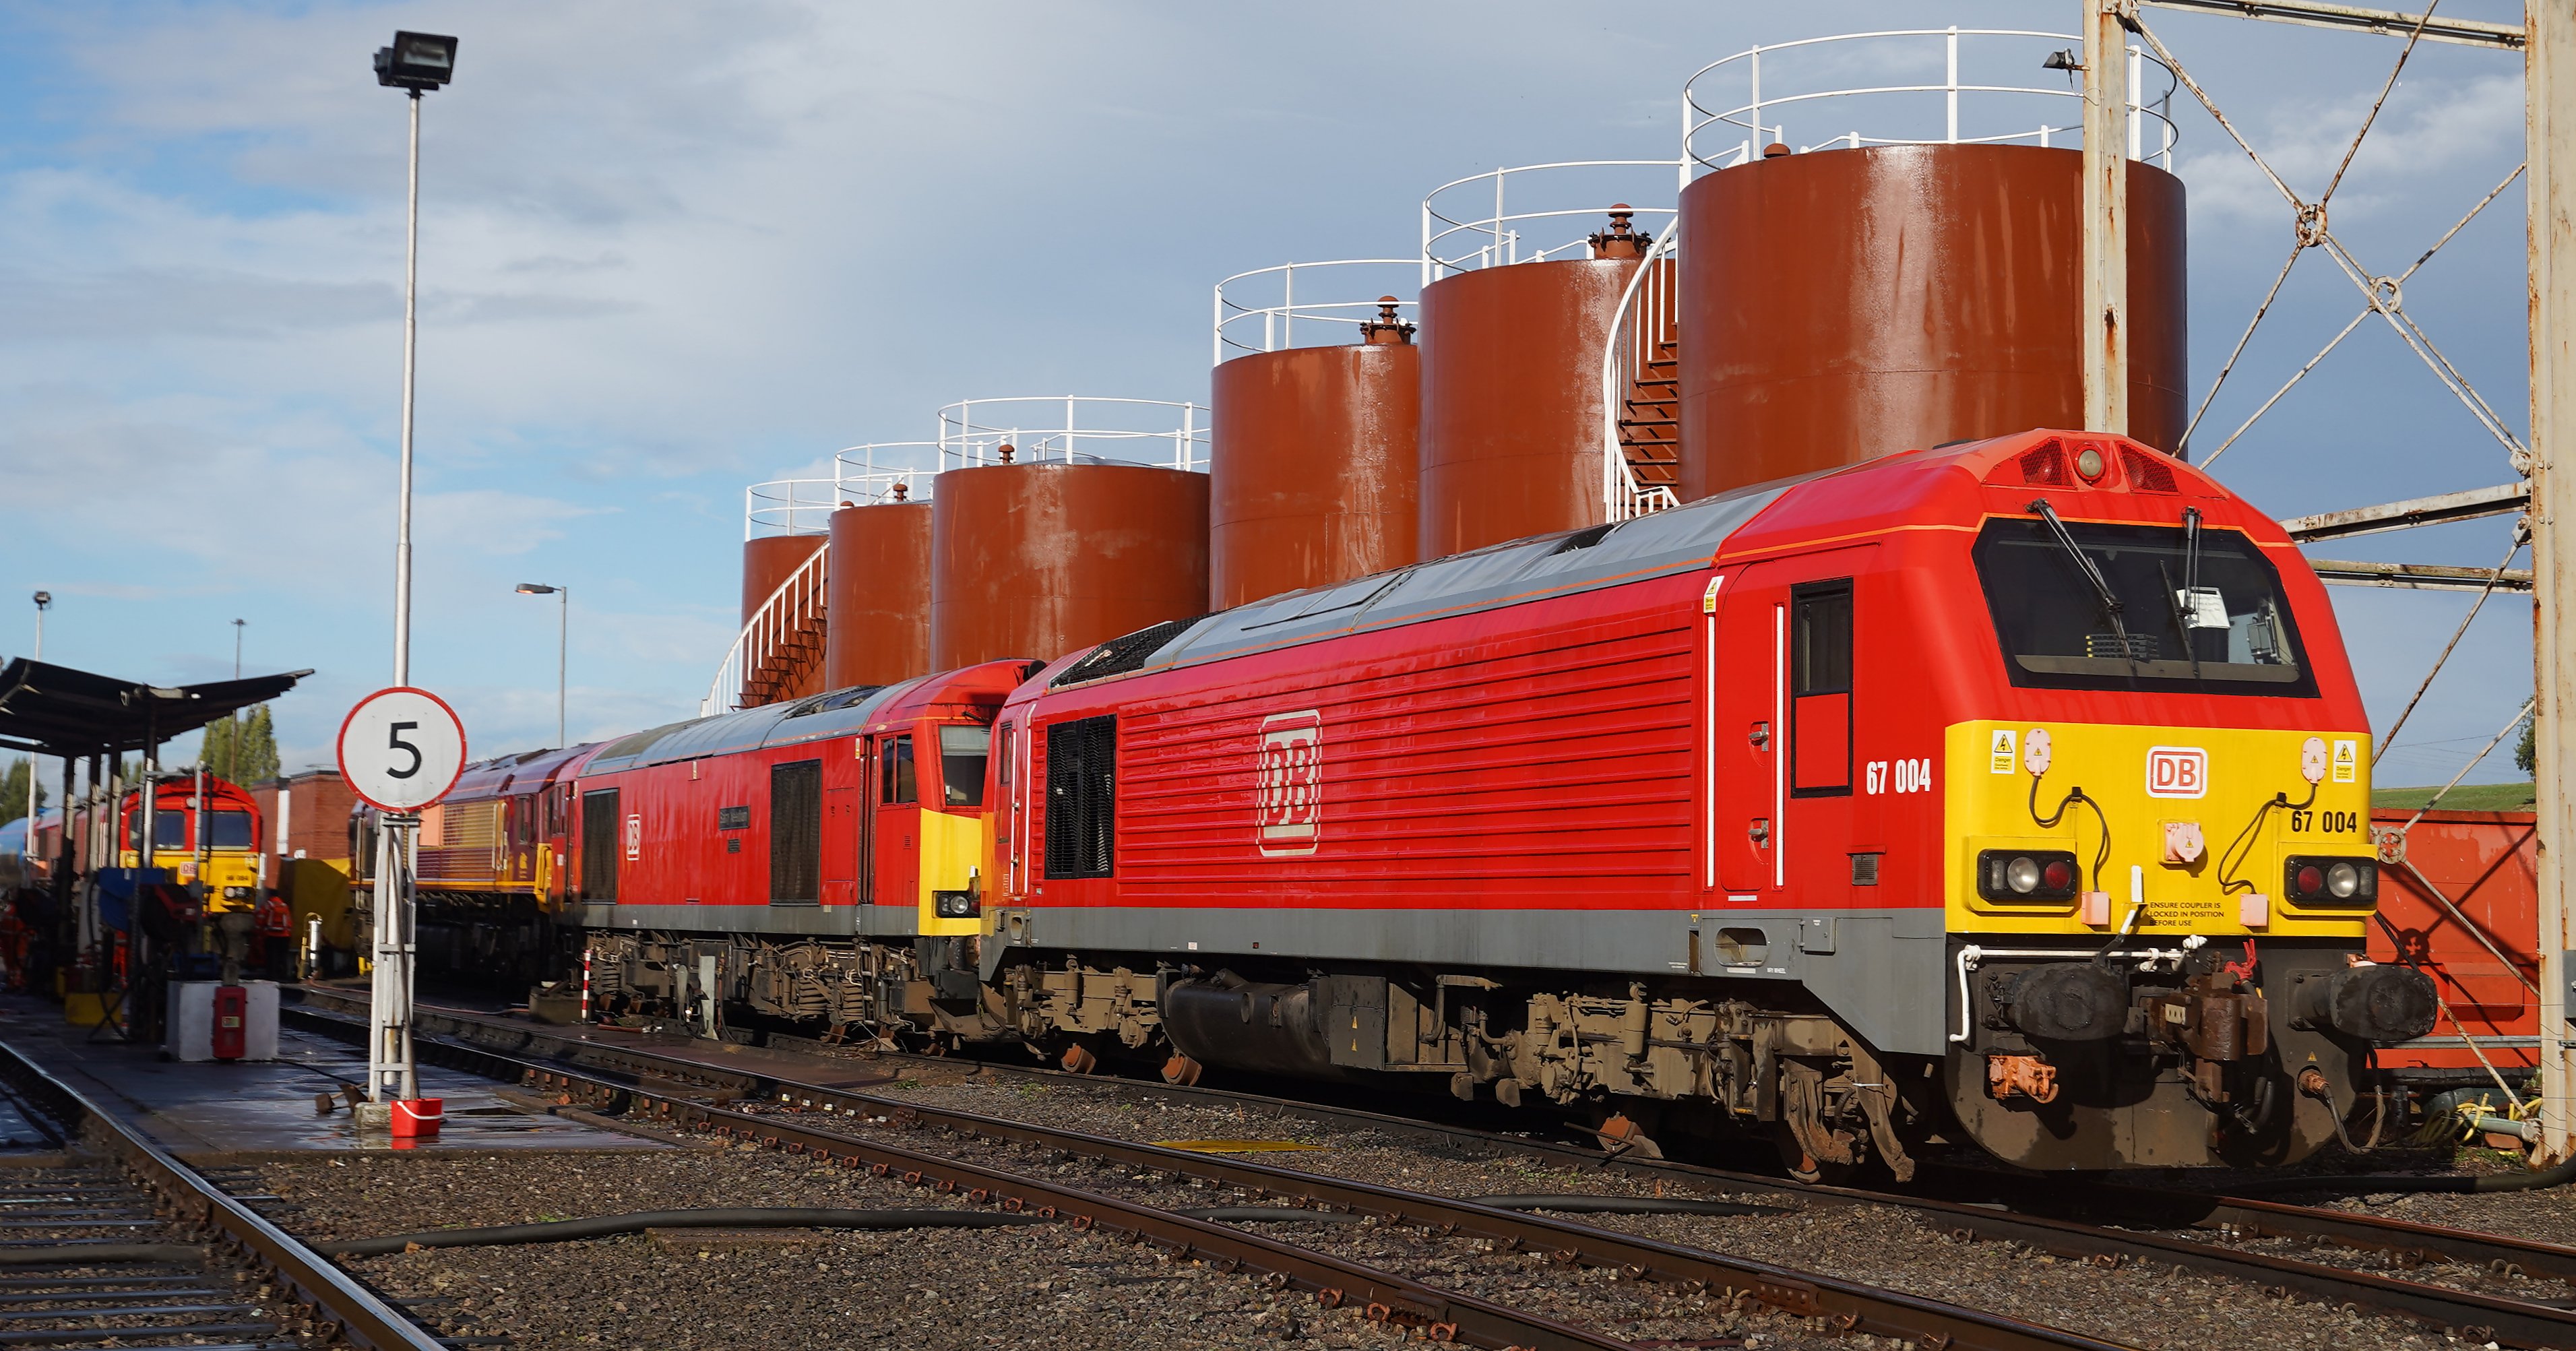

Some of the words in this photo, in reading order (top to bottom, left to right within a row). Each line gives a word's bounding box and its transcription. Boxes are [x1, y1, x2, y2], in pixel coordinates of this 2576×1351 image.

[385, 720, 422, 780] 5
[1265, 737, 1313, 826] DB
[1866, 761, 1888, 795] 67
[1895, 758, 1931, 794] 004
[2157, 758, 2196, 787] DB
[2292, 810, 2313, 832] 67
[2322, 811, 2357, 833] 004
